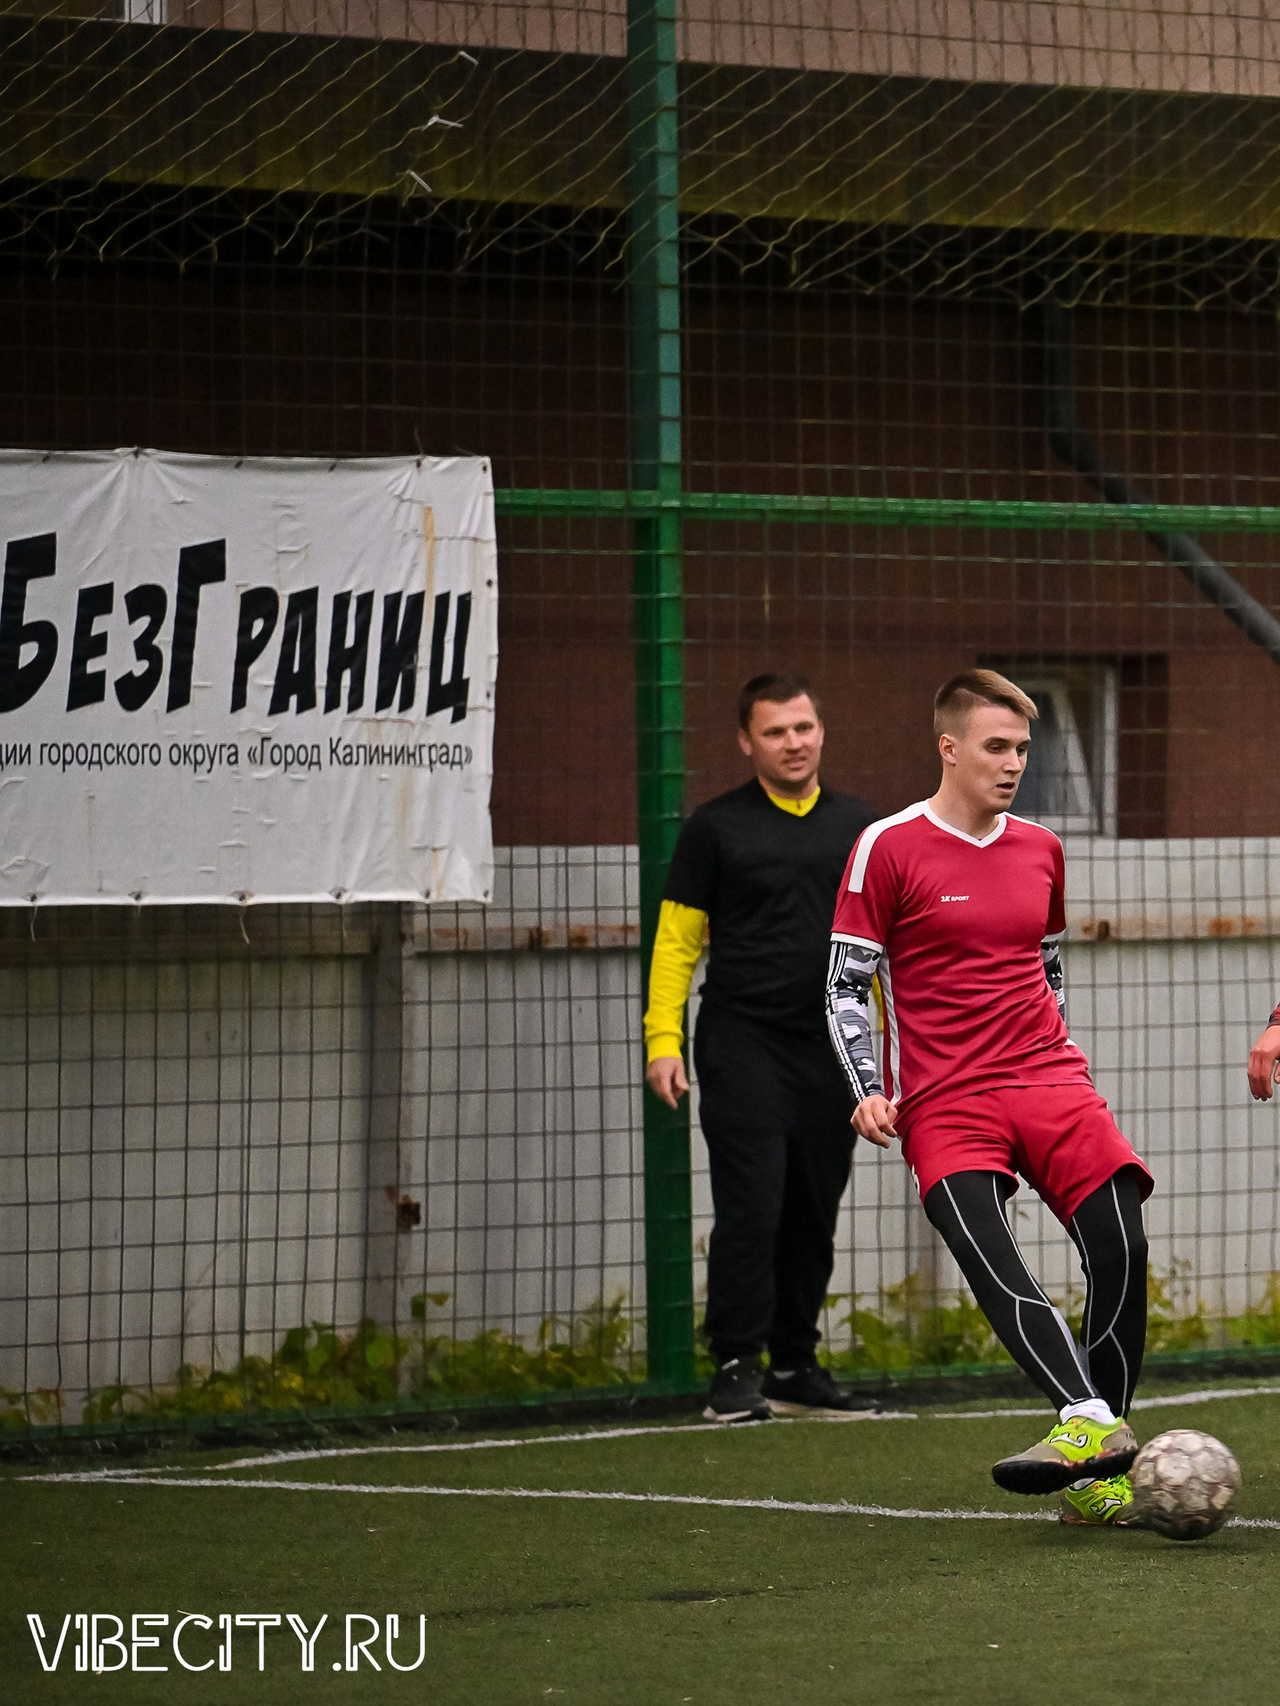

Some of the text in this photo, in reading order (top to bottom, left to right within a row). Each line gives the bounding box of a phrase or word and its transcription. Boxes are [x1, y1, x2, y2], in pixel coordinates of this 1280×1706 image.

[0, 736, 473, 774] ии городского округа «Город Калининград»
